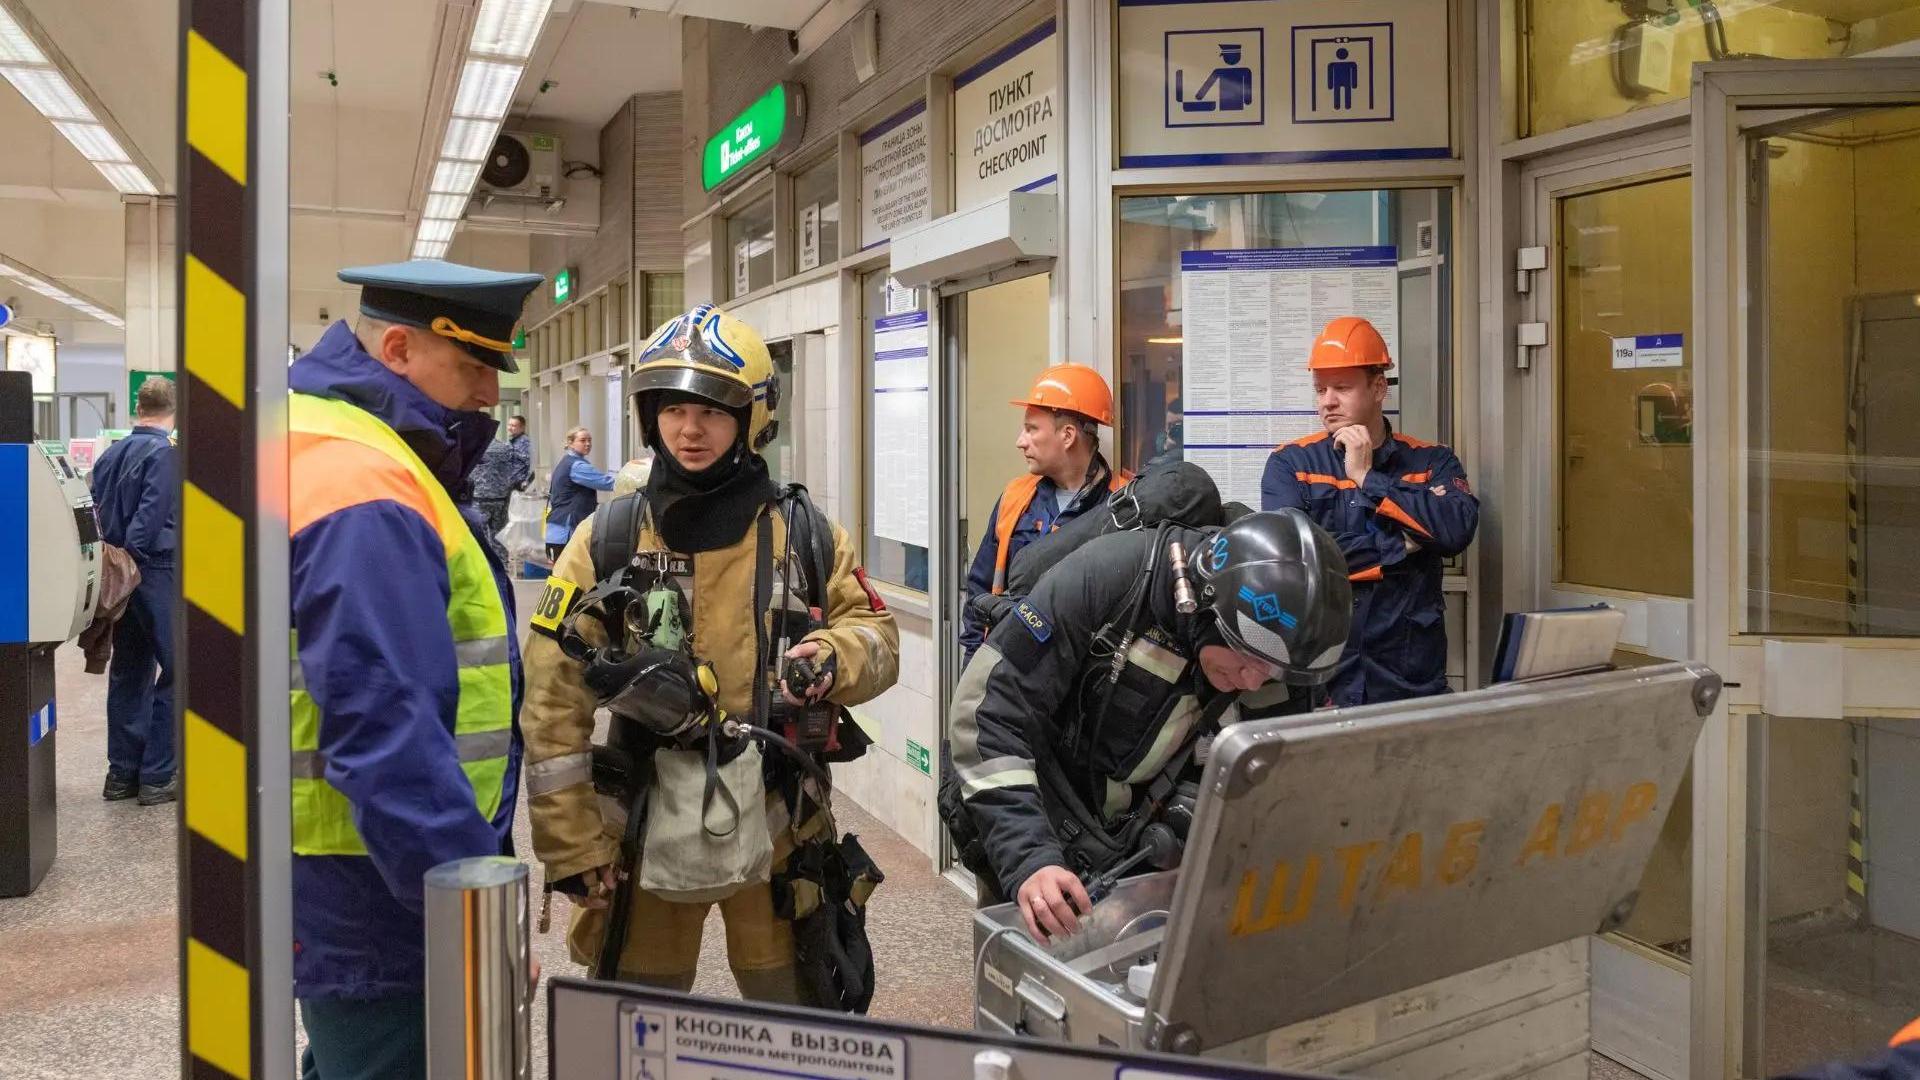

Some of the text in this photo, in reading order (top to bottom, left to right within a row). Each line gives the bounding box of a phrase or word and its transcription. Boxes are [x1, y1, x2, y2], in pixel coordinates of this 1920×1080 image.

[988, 70, 1034, 115] ПУНКТ
[881, 121, 923, 151] ГРАНИЦА ЗОНЫ
[973, 95, 1053, 157] ДОСМОТРА
[978, 133, 1047, 180] CHECKPOINT
[1229, 781, 1660, 938] ШТАБ АВР
[675, 1016, 894, 1060] КНОПКА ВЫЗОВА
[676, 1036, 895, 1076] сотрудника метрополитена
